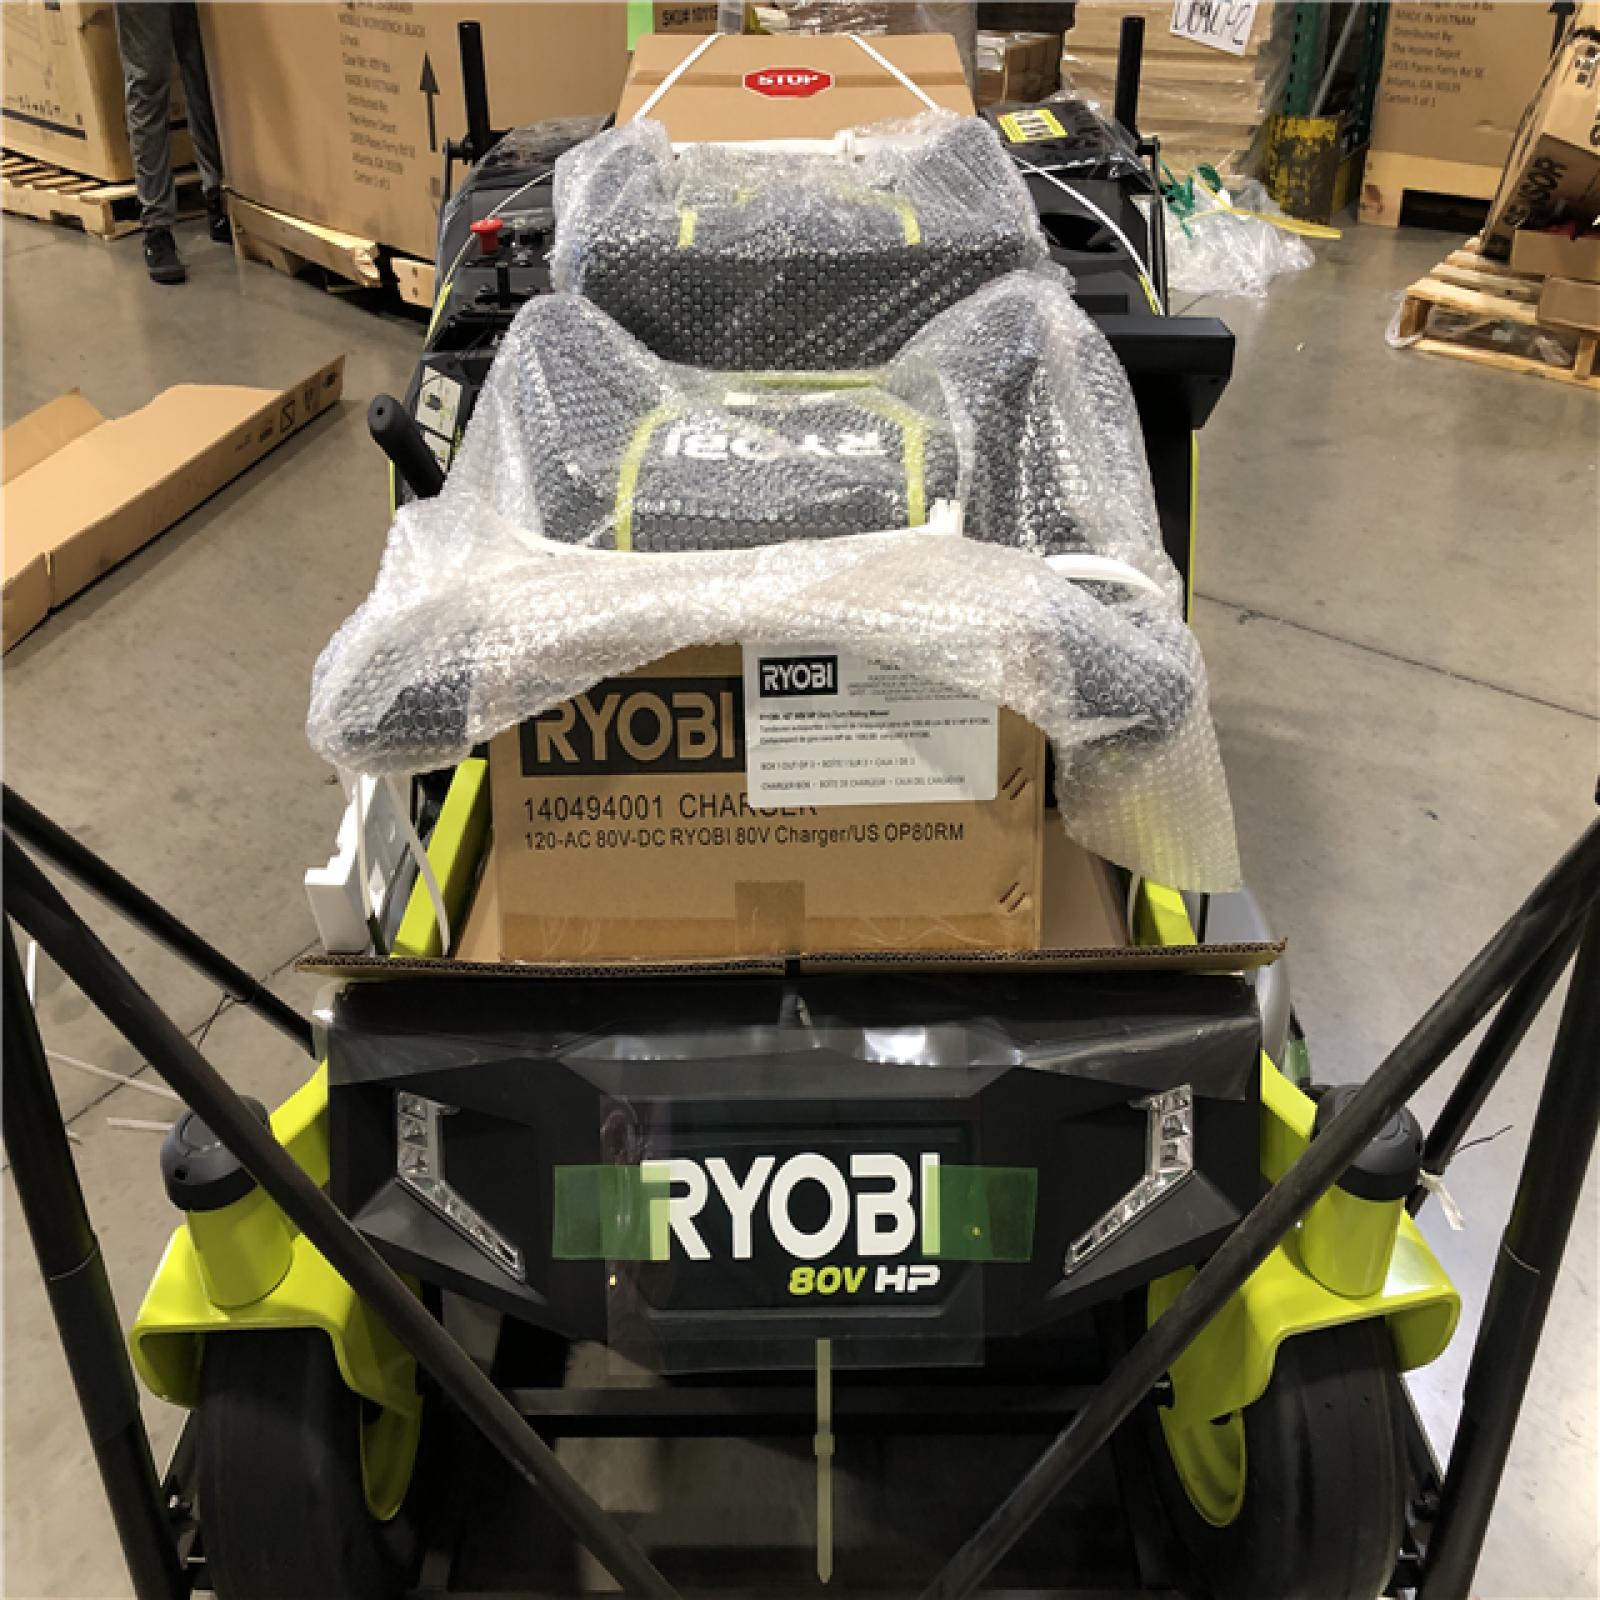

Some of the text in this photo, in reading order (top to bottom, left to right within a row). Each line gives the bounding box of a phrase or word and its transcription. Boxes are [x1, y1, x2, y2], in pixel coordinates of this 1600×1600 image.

[1391, 42, 1406, 53] The
[1435, 46, 1461, 60] Depot
[757, 74, 819, 86] STOP
[761, 662, 834, 691] RYOBI
[534, 692, 735, 763] RYOBI
[524, 794, 664, 822] 140494001
[524, 822, 964, 850] 120-AC 80V-DC RYOBI 80V Charger/US OP80RM
[639, 1151, 941, 1261] RYOBI
[788, 1264, 941, 1296] 80V HP
